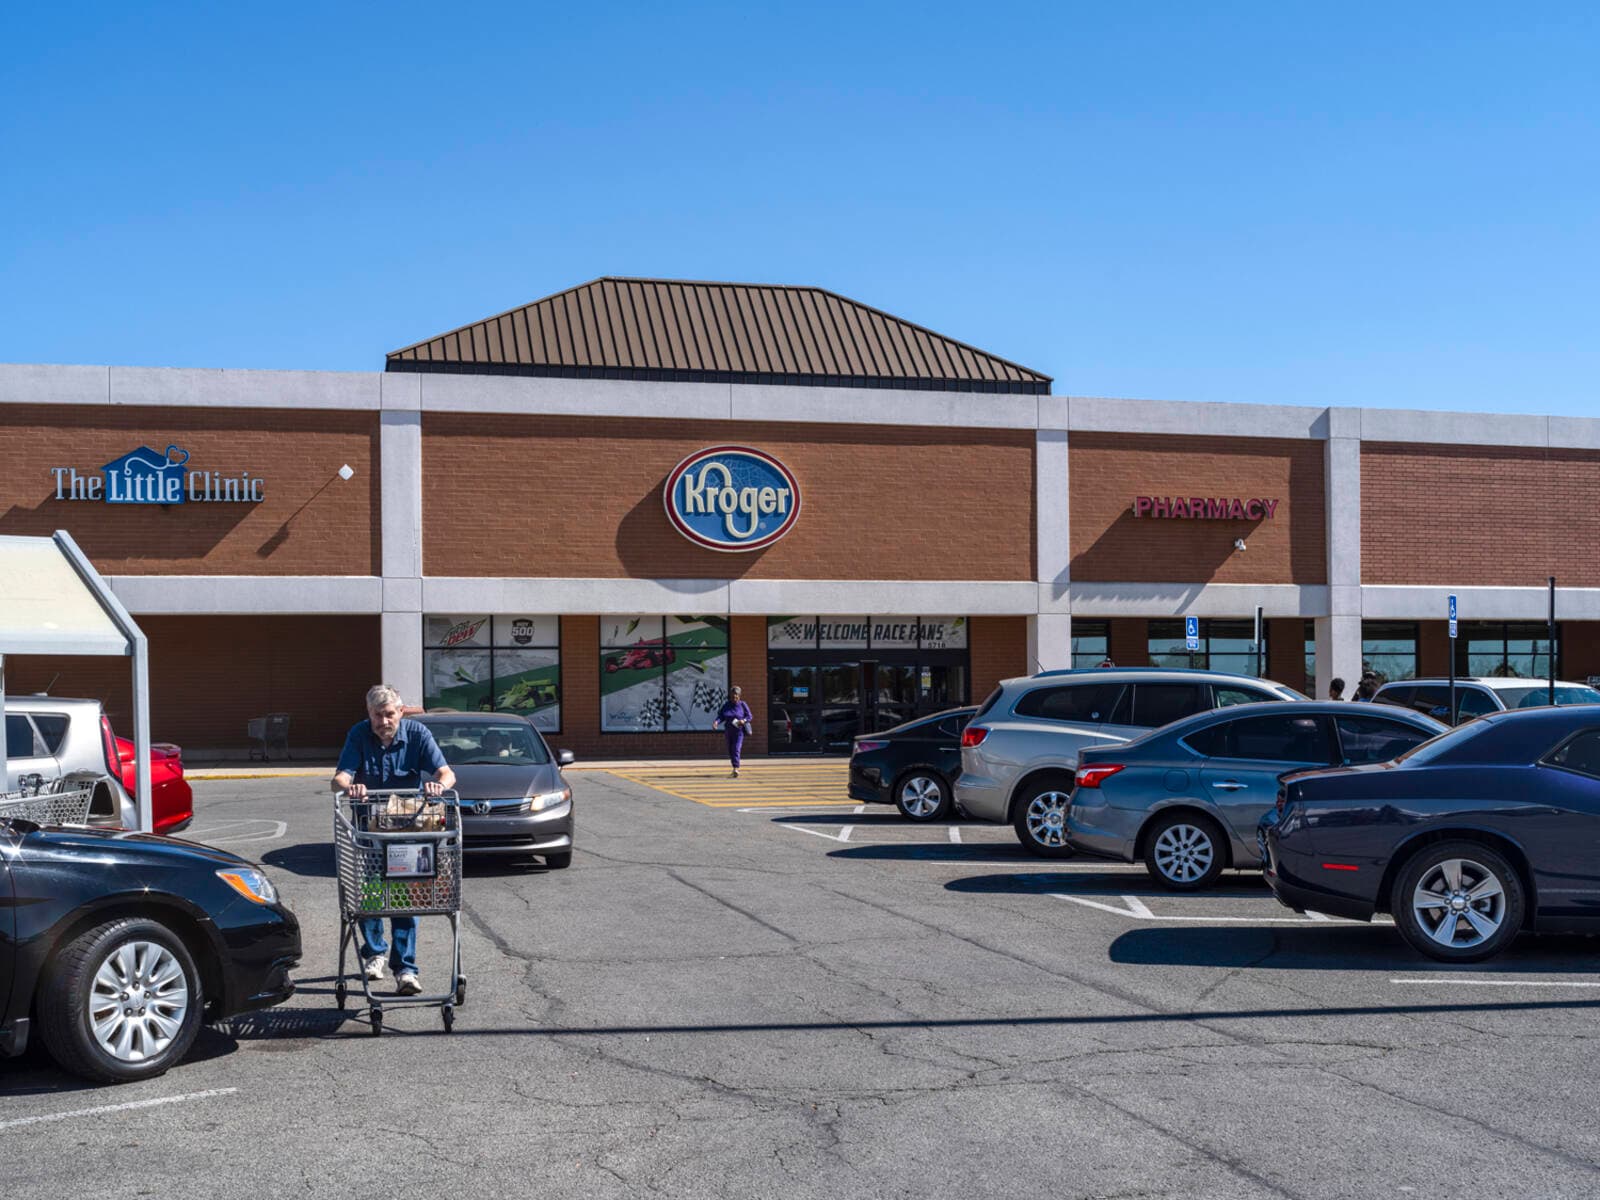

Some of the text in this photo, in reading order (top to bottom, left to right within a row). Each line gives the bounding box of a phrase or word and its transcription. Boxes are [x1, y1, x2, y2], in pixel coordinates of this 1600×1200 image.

[51, 467, 265, 503] The Little Clinic
[684, 461, 789, 539] Kroger
[1134, 496, 1279, 521] PHARMACY
[512, 626, 534, 637] 500
[803, 623, 945, 641] WELCOME RACE FANS
